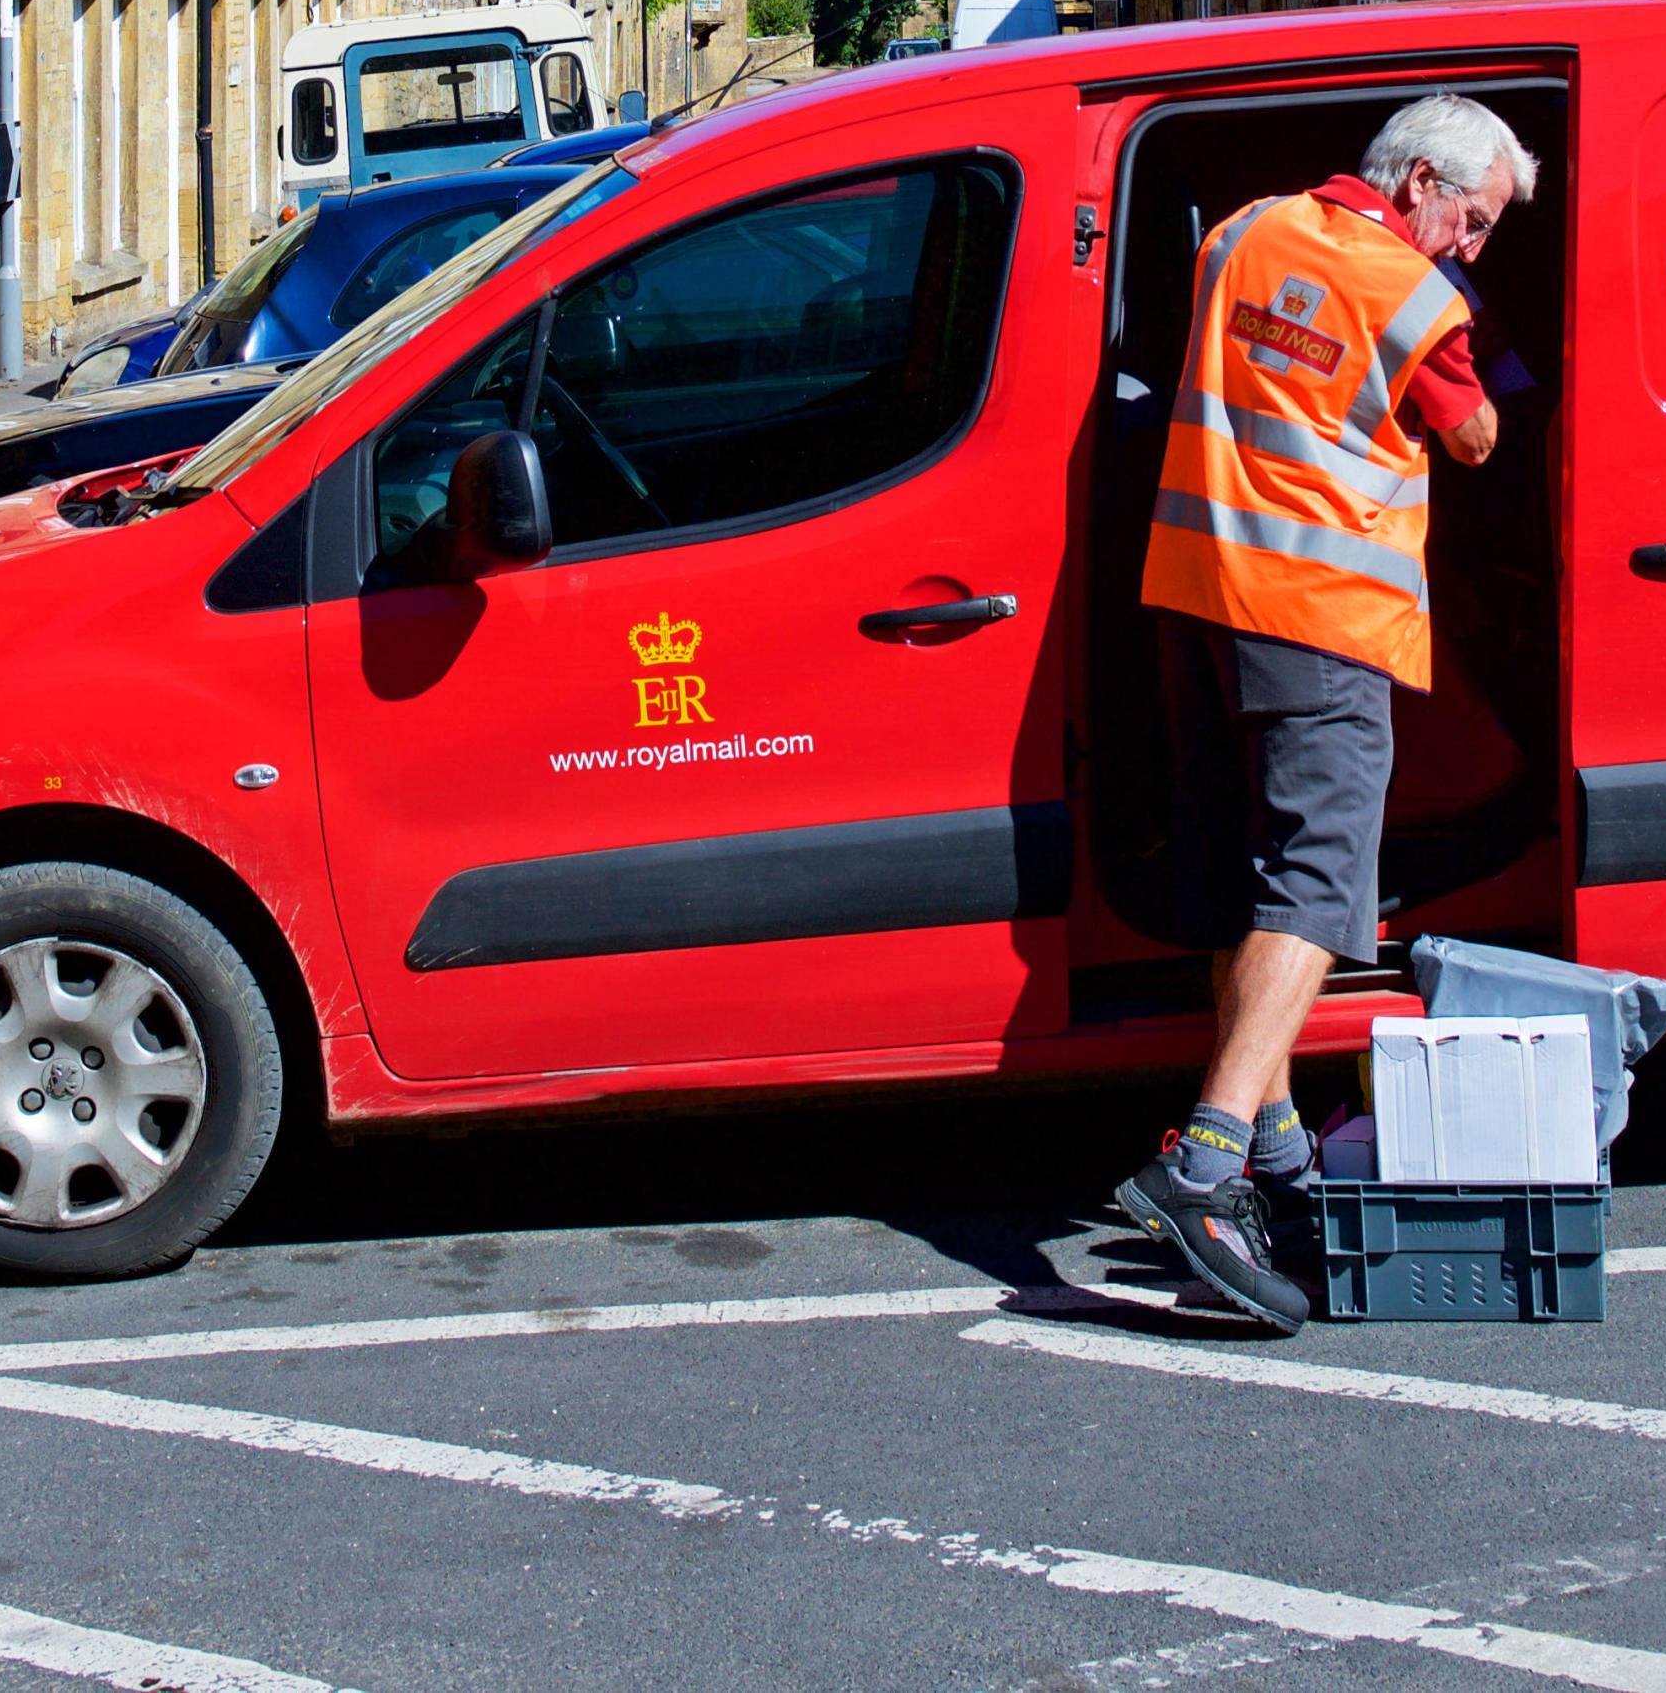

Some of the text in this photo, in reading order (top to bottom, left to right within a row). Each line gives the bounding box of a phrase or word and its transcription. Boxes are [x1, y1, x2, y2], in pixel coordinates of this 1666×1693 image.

[1235, 308, 1336, 366] Royal Mail
[549, 734, 814, 772] www.royalmail.com
[44, 776, 62, 789] 33
